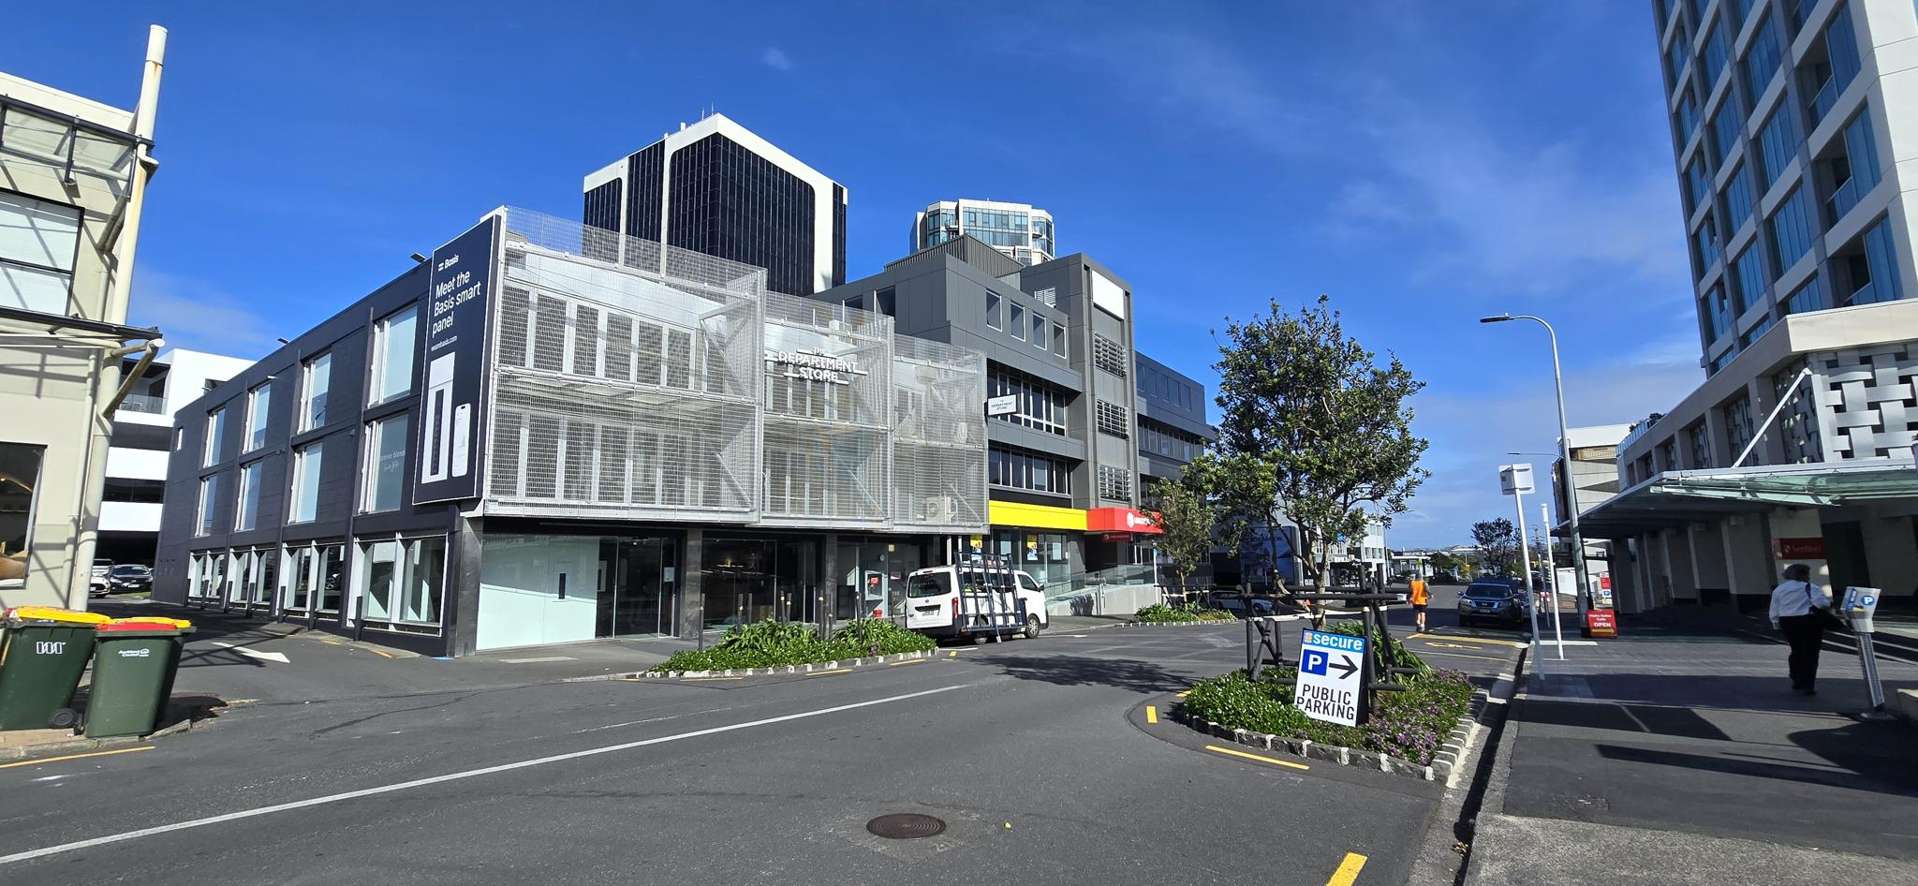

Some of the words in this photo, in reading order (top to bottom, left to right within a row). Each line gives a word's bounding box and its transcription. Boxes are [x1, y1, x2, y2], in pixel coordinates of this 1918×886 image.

[435, 277, 455, 299] Meet
[456, 271, 471, 288] the
[434, 295, 455, 317] Basis
[456, 281, 482, 306] smart
[432, 311, 454, 339] panel
[778, 351, 858, 373] DEPARTMENT
[799, 367, 838, 383] STORE
[1313, 634, 1362, 650] secure
[1308, 654, 1322, 671] P
[1302, 684, 1351, 706] PUBLIC
[1297, 696, 1355, 720] PARKING
